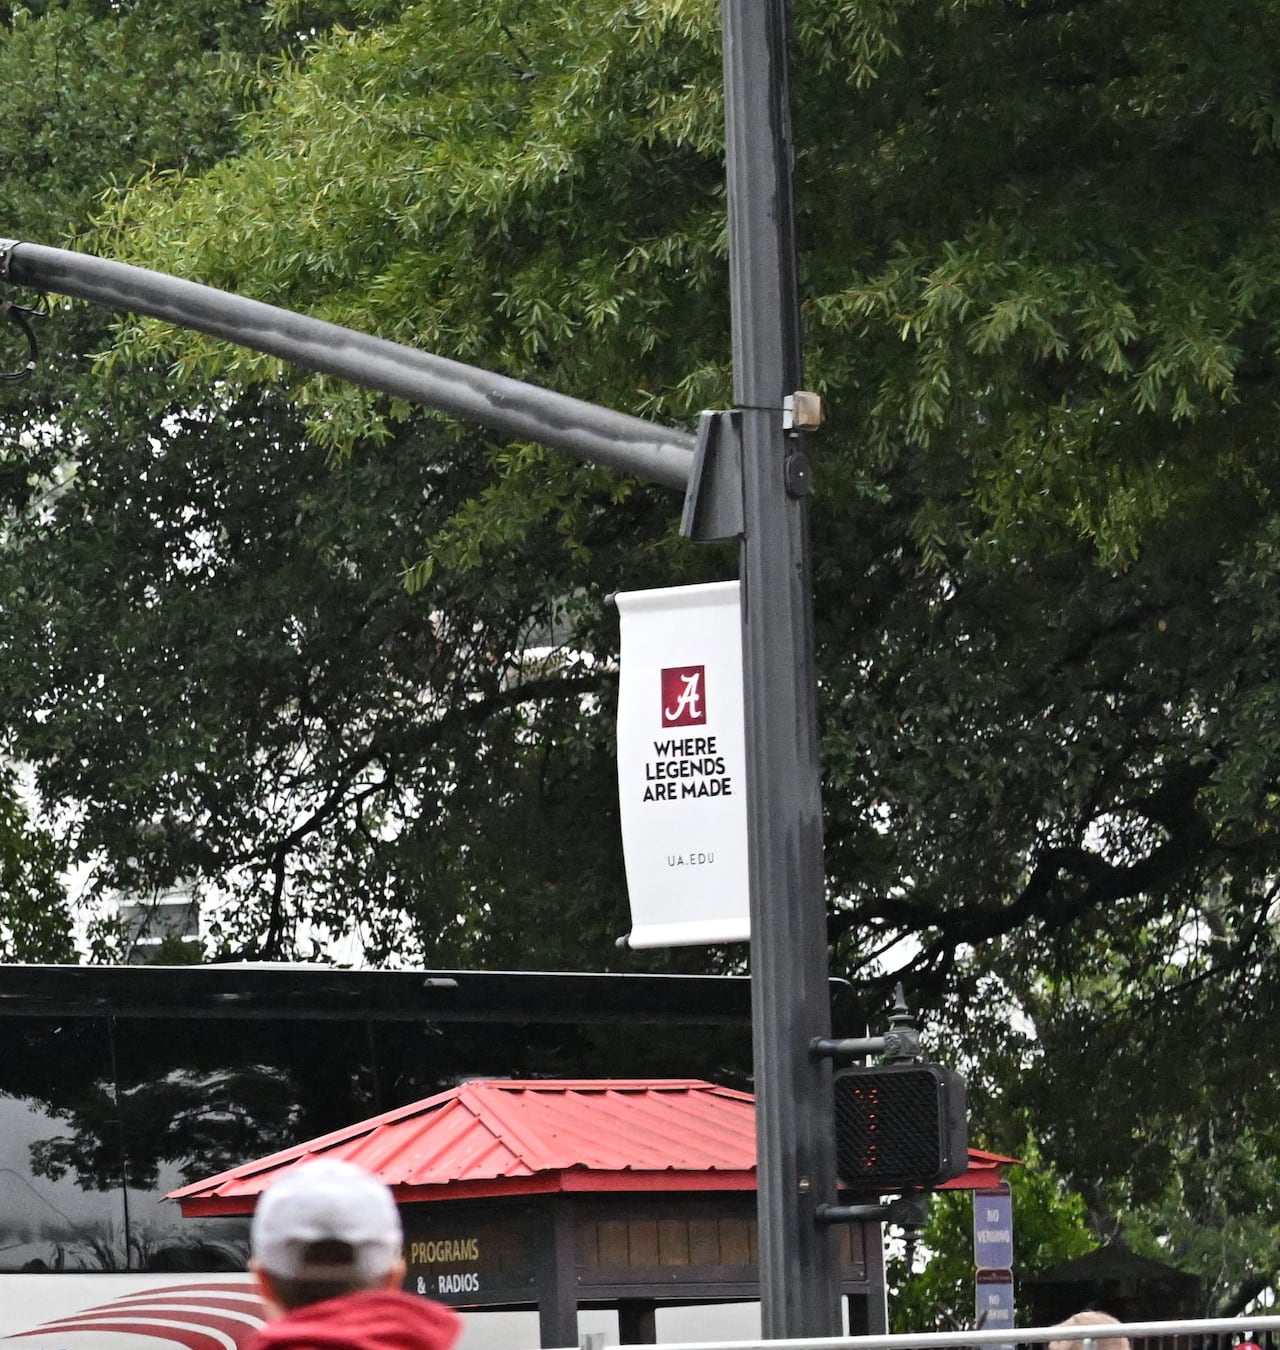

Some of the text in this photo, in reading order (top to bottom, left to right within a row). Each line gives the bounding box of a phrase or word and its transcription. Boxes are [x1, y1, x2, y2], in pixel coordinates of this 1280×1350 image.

[654, 737, 717, 757] WHERE
[646, 758, 726, 780] LEGENDS
[643, 778, 732, 802] ARE MADE
[667, 853, 715, 866] UA.EDU
[986, 1209, 999, 1222] NO
[411, 1239, 479, 1263] PROGRAMS
[417, 1273, 479, 1294] & RADIOS
